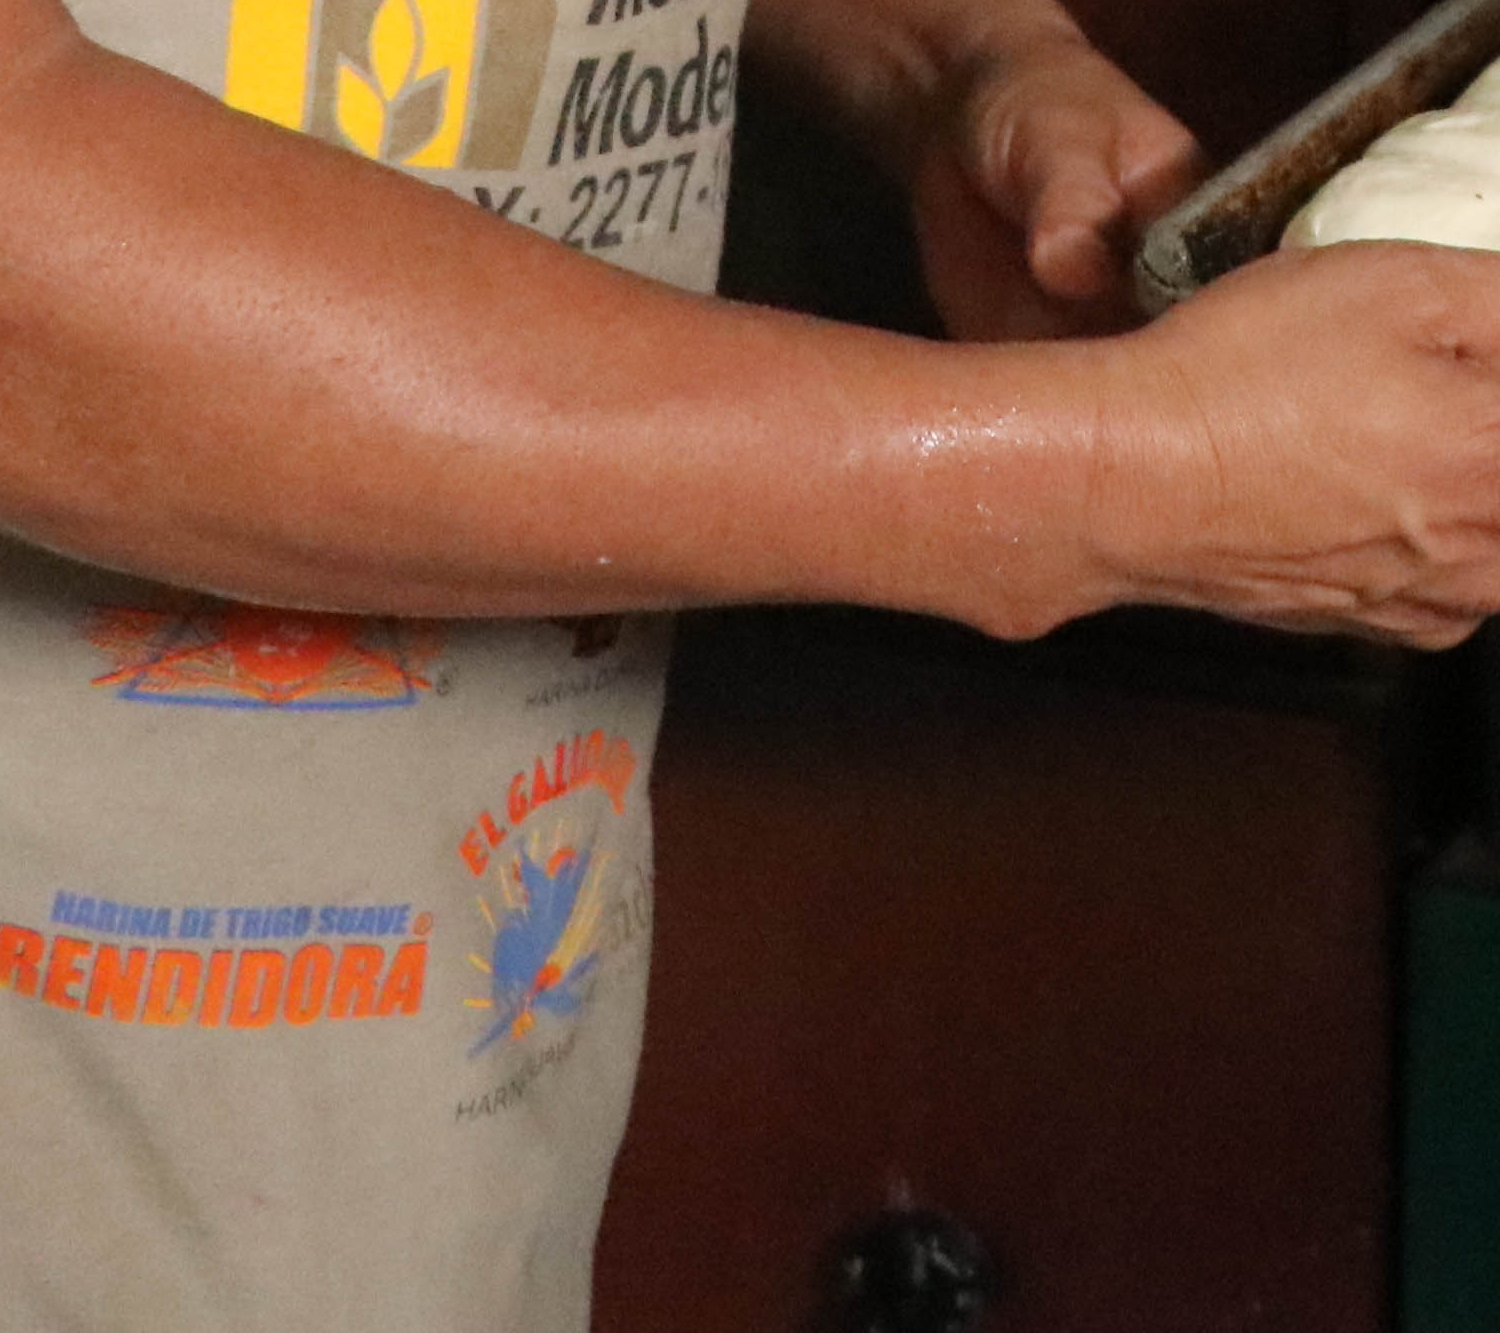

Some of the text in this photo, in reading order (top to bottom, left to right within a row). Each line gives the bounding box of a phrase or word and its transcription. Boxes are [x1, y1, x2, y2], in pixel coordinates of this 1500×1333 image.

[458, 809, 508, 879] EL
[50, 889, 413, 939] HARINA DE TRIGO SUAVE
